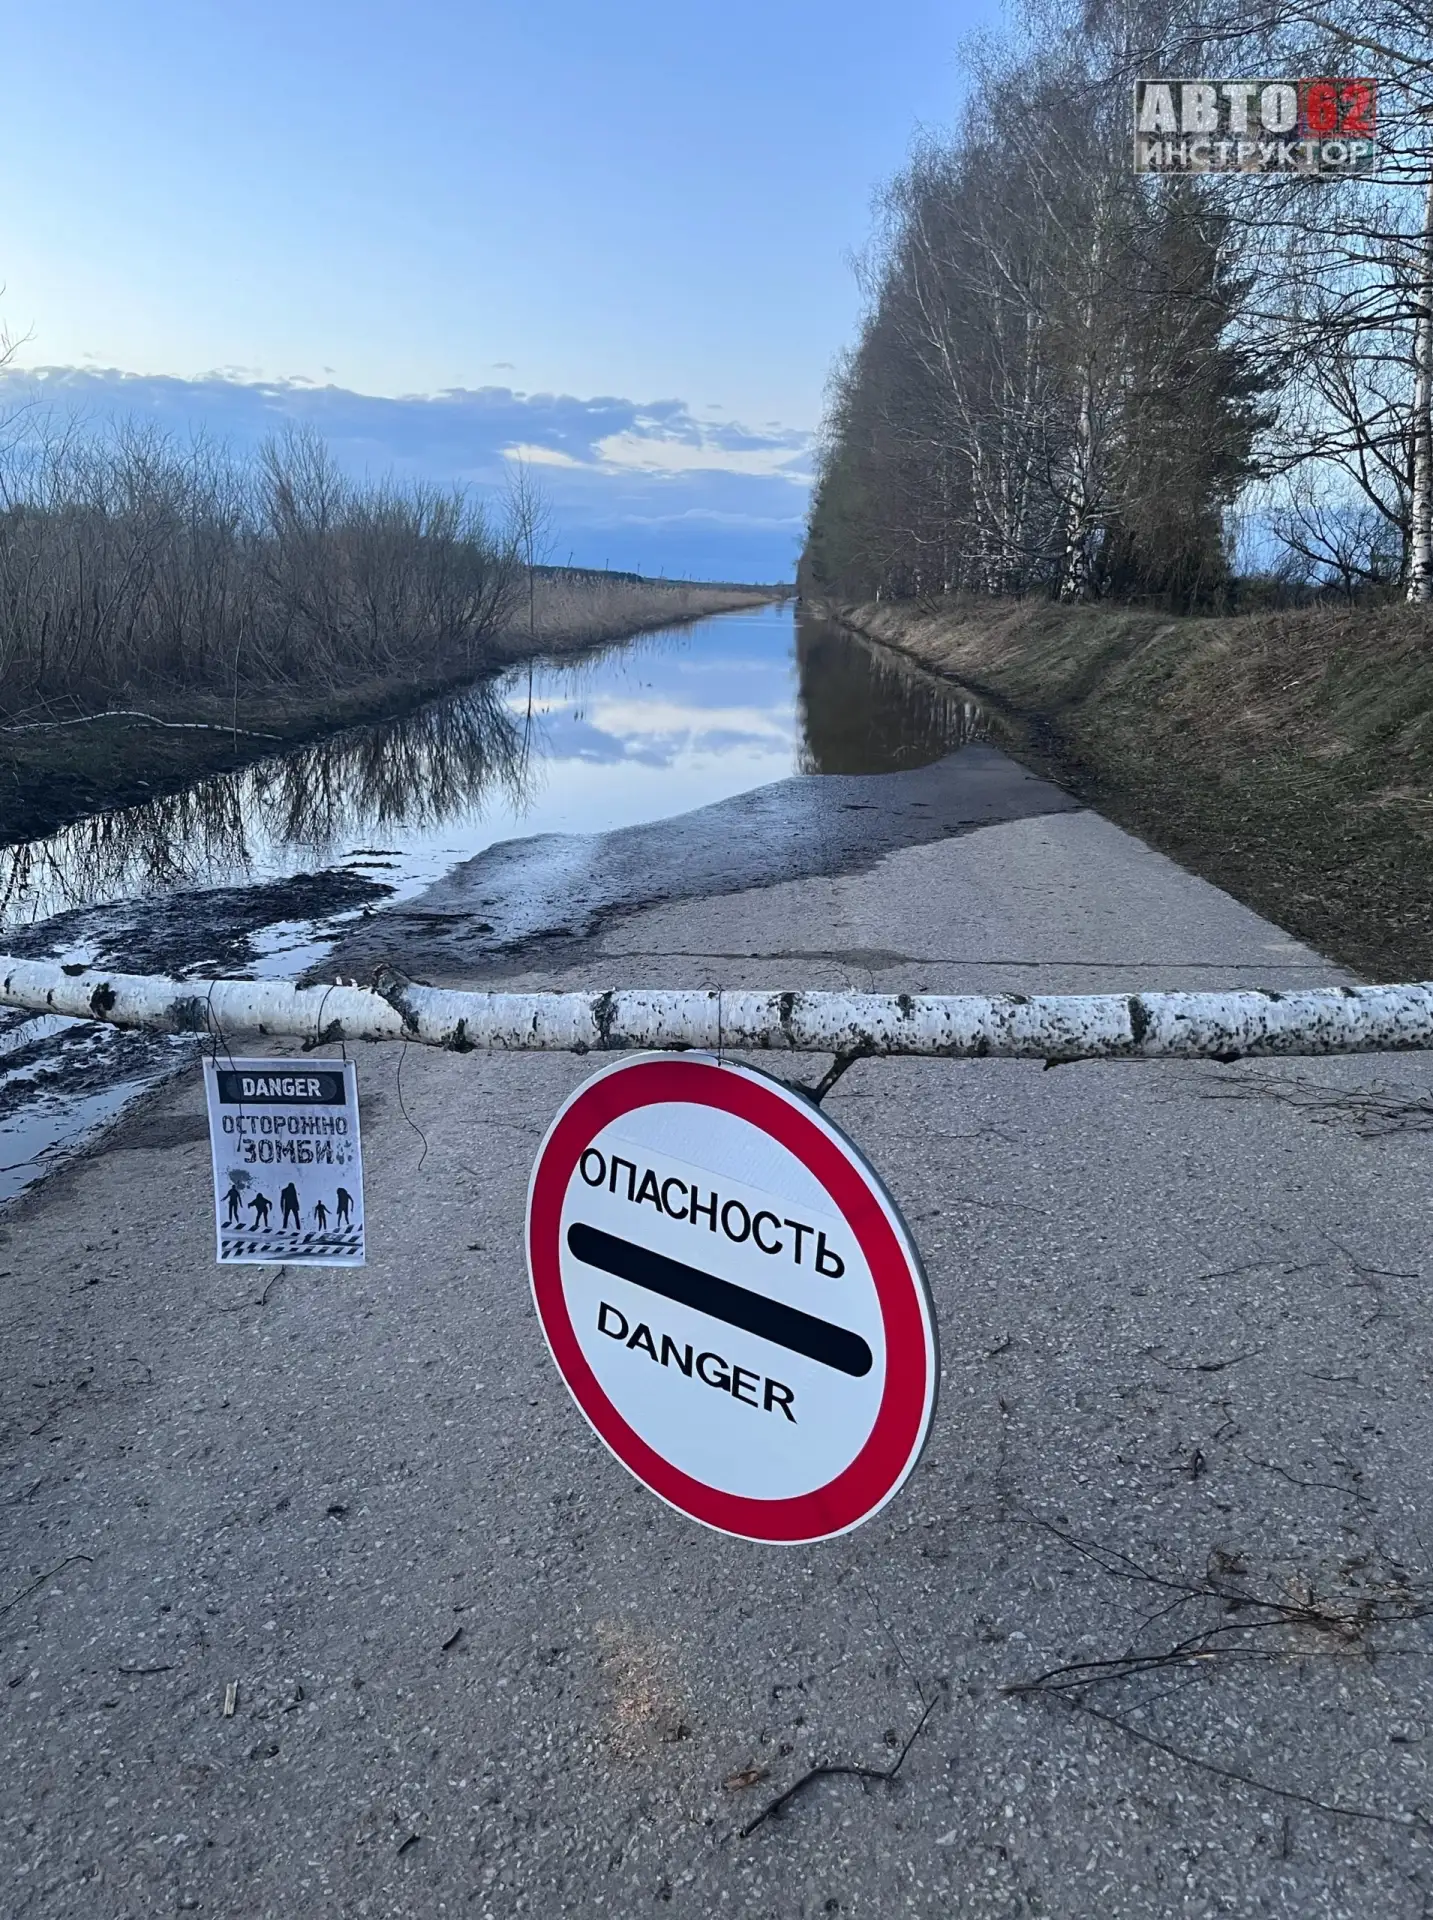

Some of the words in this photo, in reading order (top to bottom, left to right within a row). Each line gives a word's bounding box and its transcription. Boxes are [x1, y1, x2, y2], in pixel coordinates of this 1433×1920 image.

[242, 1077, 322, 1097] DANGER
[221, 1115, 348, 1136] ОСТОРОЖНО
[579, 1147, 845, 1280] ОПАСНОСТЬ
[597, 1301, 798, 1424] DANGER
